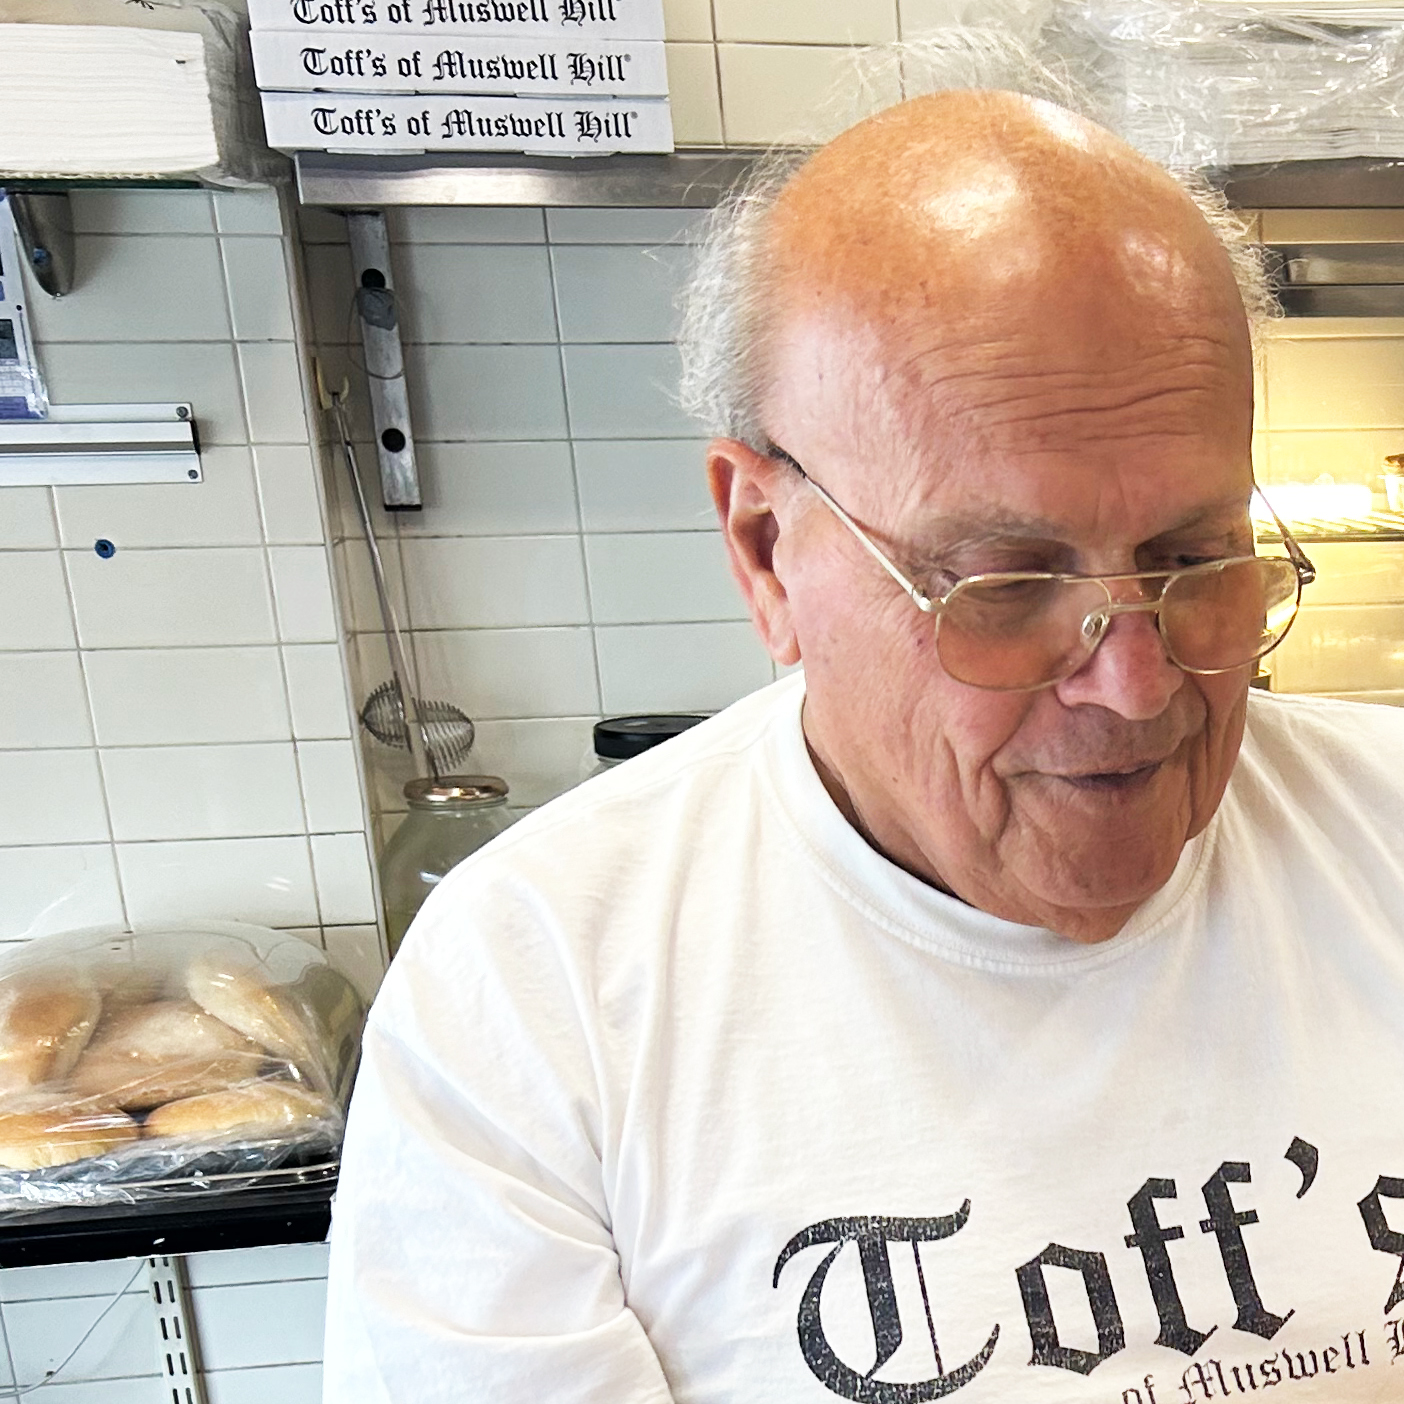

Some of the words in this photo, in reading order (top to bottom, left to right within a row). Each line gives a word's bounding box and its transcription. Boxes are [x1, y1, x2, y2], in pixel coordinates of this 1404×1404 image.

[388, 0, 412, 24] of
[423, 0, 549, 27] Muswell
[300, 47, 387, 78] Toff's
[397, 50, 423, 78] of
[432, 50, 559, 81] Muswell
[311, 107, 397, 136] Toff's
[407, 111, 431, 137] of
[440, 110, 566, 140] Muswell
